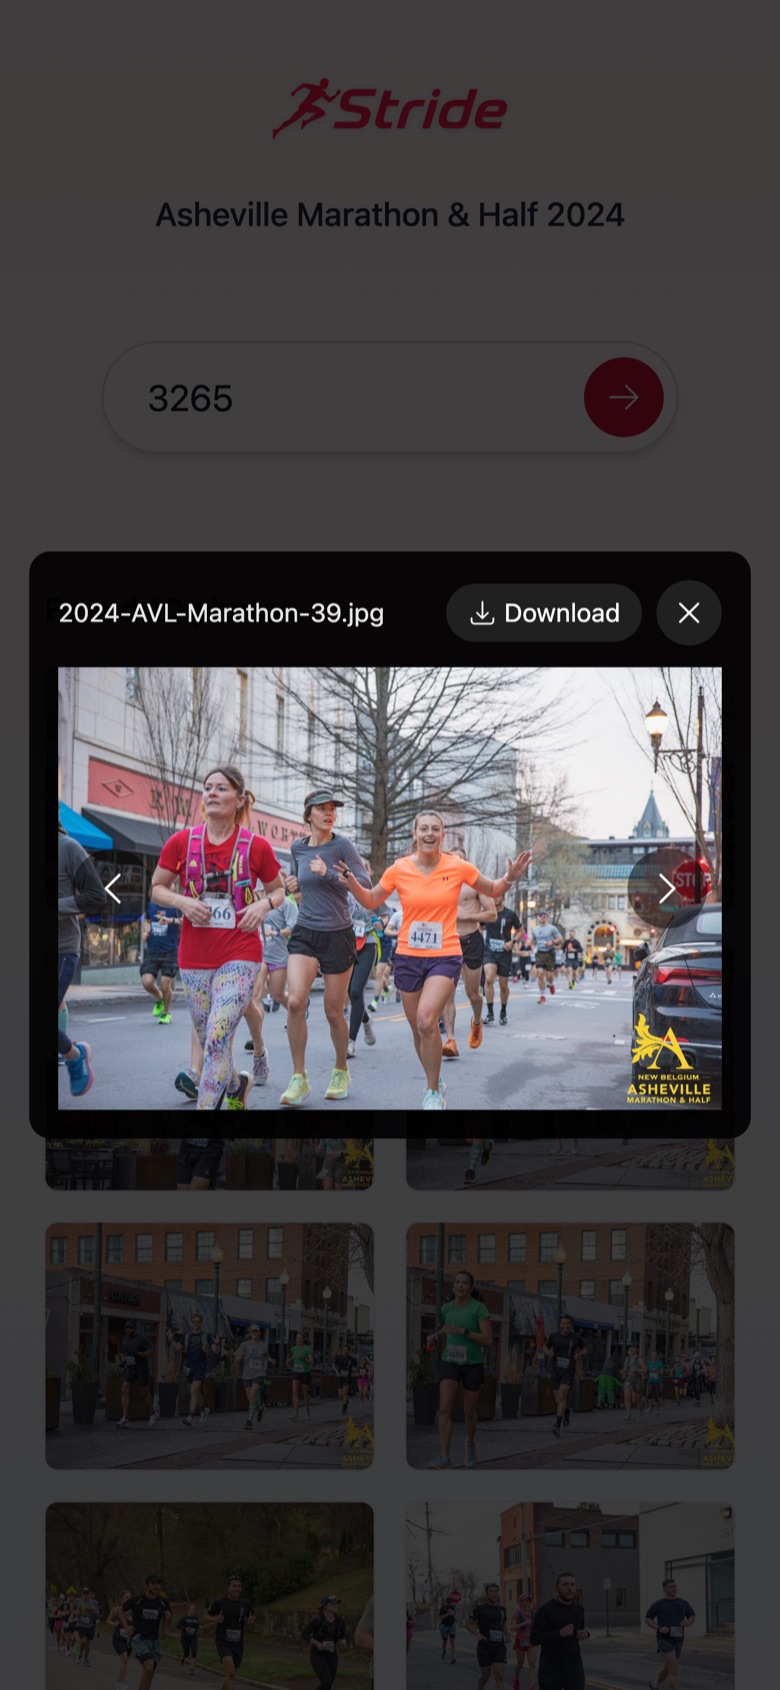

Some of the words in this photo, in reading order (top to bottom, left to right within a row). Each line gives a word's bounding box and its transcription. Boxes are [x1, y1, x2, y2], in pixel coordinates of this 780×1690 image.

[333, 88, 508, 130] Stride
[156, 201, 287, 227] Asheville
[298, 201, 438, 227] Marathon
[448, 202, 470, 227] &
[480, 201, 538, 227] Half
[548, 202, 624, 227] 2024
[148, 384, 233, 412] 3265
[59, 602, 384, 628] 2024-AVL-Marathon-39.jpg
[505, 602, 620, 623] Download
[209, 906, 231, 920] 66
[411, 931, 437, 944] 4471
